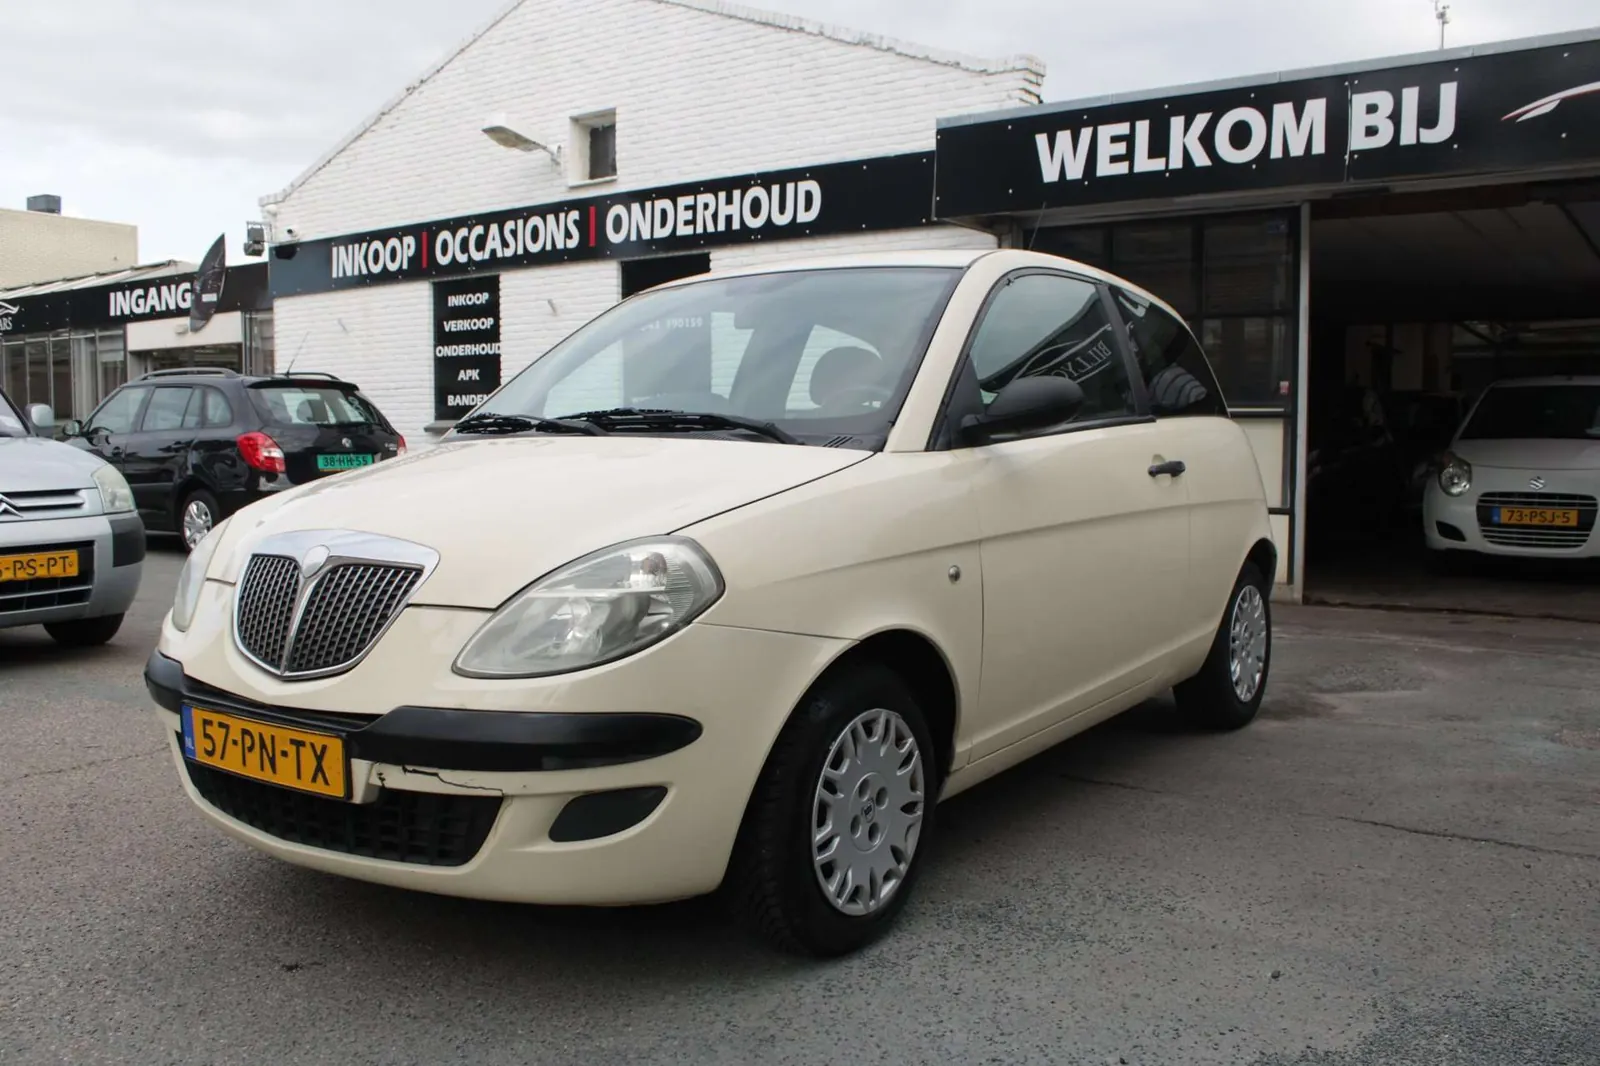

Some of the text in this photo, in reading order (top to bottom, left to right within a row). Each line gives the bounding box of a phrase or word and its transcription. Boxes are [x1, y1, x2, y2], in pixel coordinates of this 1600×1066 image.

[1035, 82, 1458, 183] WELKOM BIJ
[332, 180, 822, 278] INKOOP OCCASIONS ONDERHOUD
[109, 282, 192, 316] INGANG
[448, 292, 489, 307] INKOOP
[443, 318, 494, 332] VERKOOP
[436, 343, 501, 357] ONDERHOUD
[458, 369, 480, 380] APK
[1507, 510, 1571, 523] 73-PSJ-5
[0, 556, 69, 578] -PS-PT
[202, 719, 330, 786] 57-PN-TX
